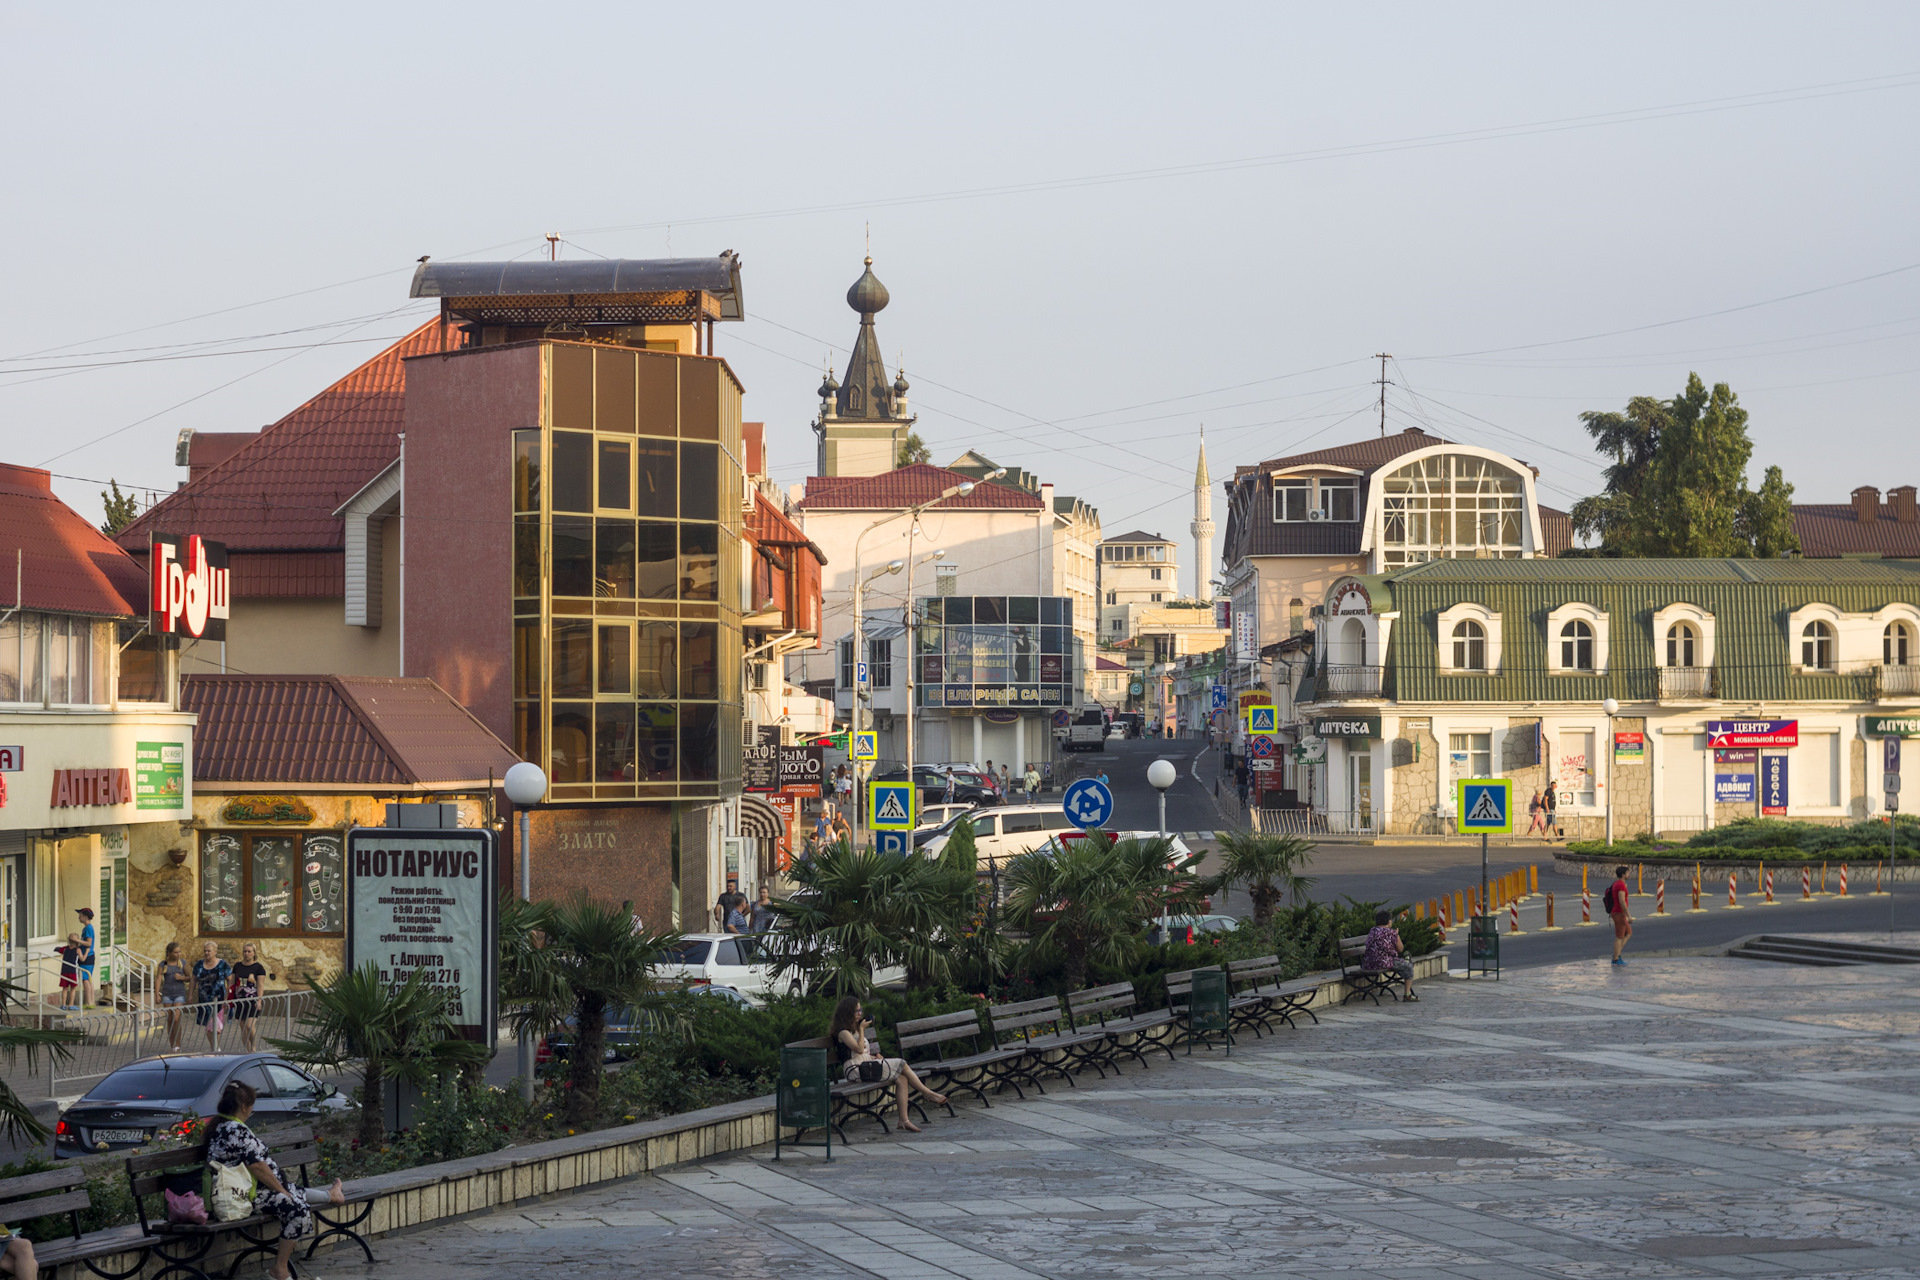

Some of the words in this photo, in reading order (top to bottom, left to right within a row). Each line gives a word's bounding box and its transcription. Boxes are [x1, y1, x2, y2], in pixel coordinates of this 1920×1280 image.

[1332, 583, 1372, 616] НЕДВИЖИМОСТЬ
[929, 687, 1018, 700] ЮВЕЛИРНЫЙ
[1021, 689, 1060, 700] САЛОН
[1734, 723, 1770, 734] ЦЕНТР
[1877, 720, 1920, 732] апте
[1734, 736, 1774, 744] МОБИЛЬНОЙ
[745, 744, 776, 758] КАФЕ
[780, 750, 808, 760] РЫМ
[1729, 752, 1744, 760] win
[780, 758, 820, 774] ЛОТО
[51, 768, 132, 808] АПТЕКА
[1717, 782, 1752, 793] АДВОКАТ
[774, 804, 792, 813] NS
[558, 832, 616, 851] ЗЛАТО
[356, 849, 478, 878] НОТАРИУС
[391, 886, 414, 895] Режим
[416, 886, 443, 896] работы:
[378, 897, 456, 906] понедельник-пятница
[399, 906, 412, 914] 9:00
[424, 906, 440, 914] 17:00
[393, 915, 406, 923] без
[399, 925, 435, 933] выходной:
[380, 934, 408, 943] суббота,
[390, 954, 398, 966] г.
[400, 952, 444, 967] Алушта
[438, 969, 451, 983] 27
[454, 969, 460, 983] б
[128, 1129, 141, 1137] 777
